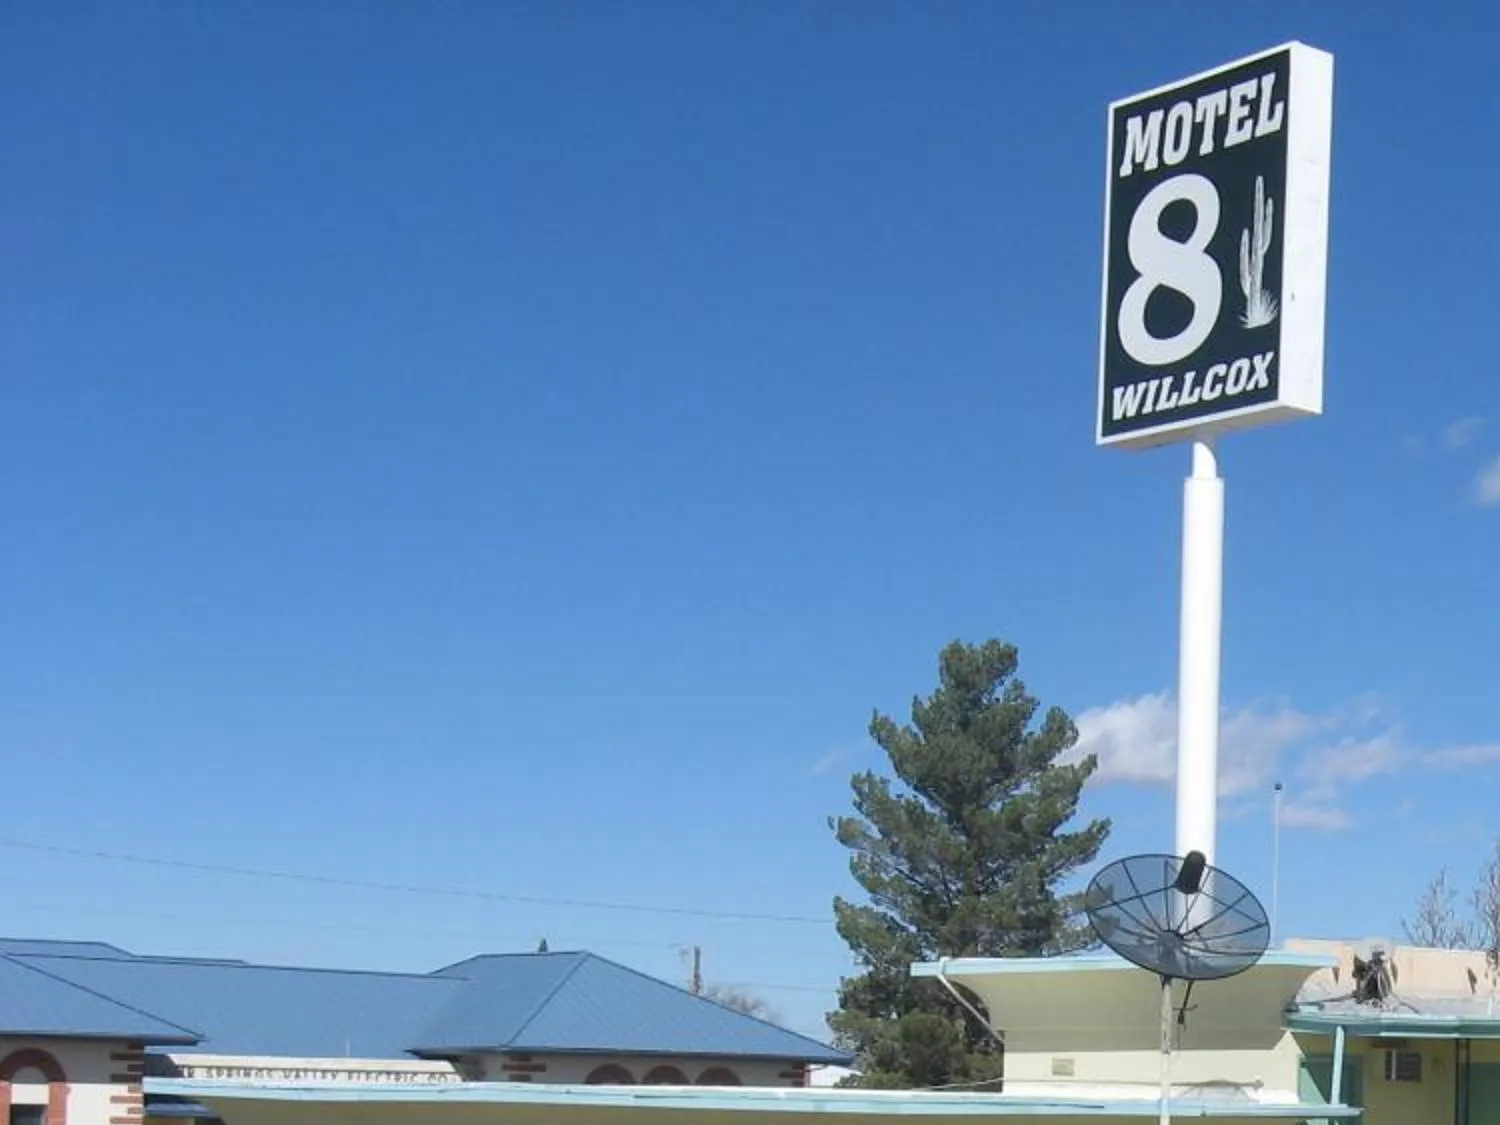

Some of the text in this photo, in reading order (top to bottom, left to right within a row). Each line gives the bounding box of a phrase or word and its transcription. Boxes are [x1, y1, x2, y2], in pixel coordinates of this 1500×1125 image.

[1119, 72, 1284, 177] MOTEL
[1117, 173, 1223, 365] 8
[1112, 352, 1274, 421] WILLCOX
